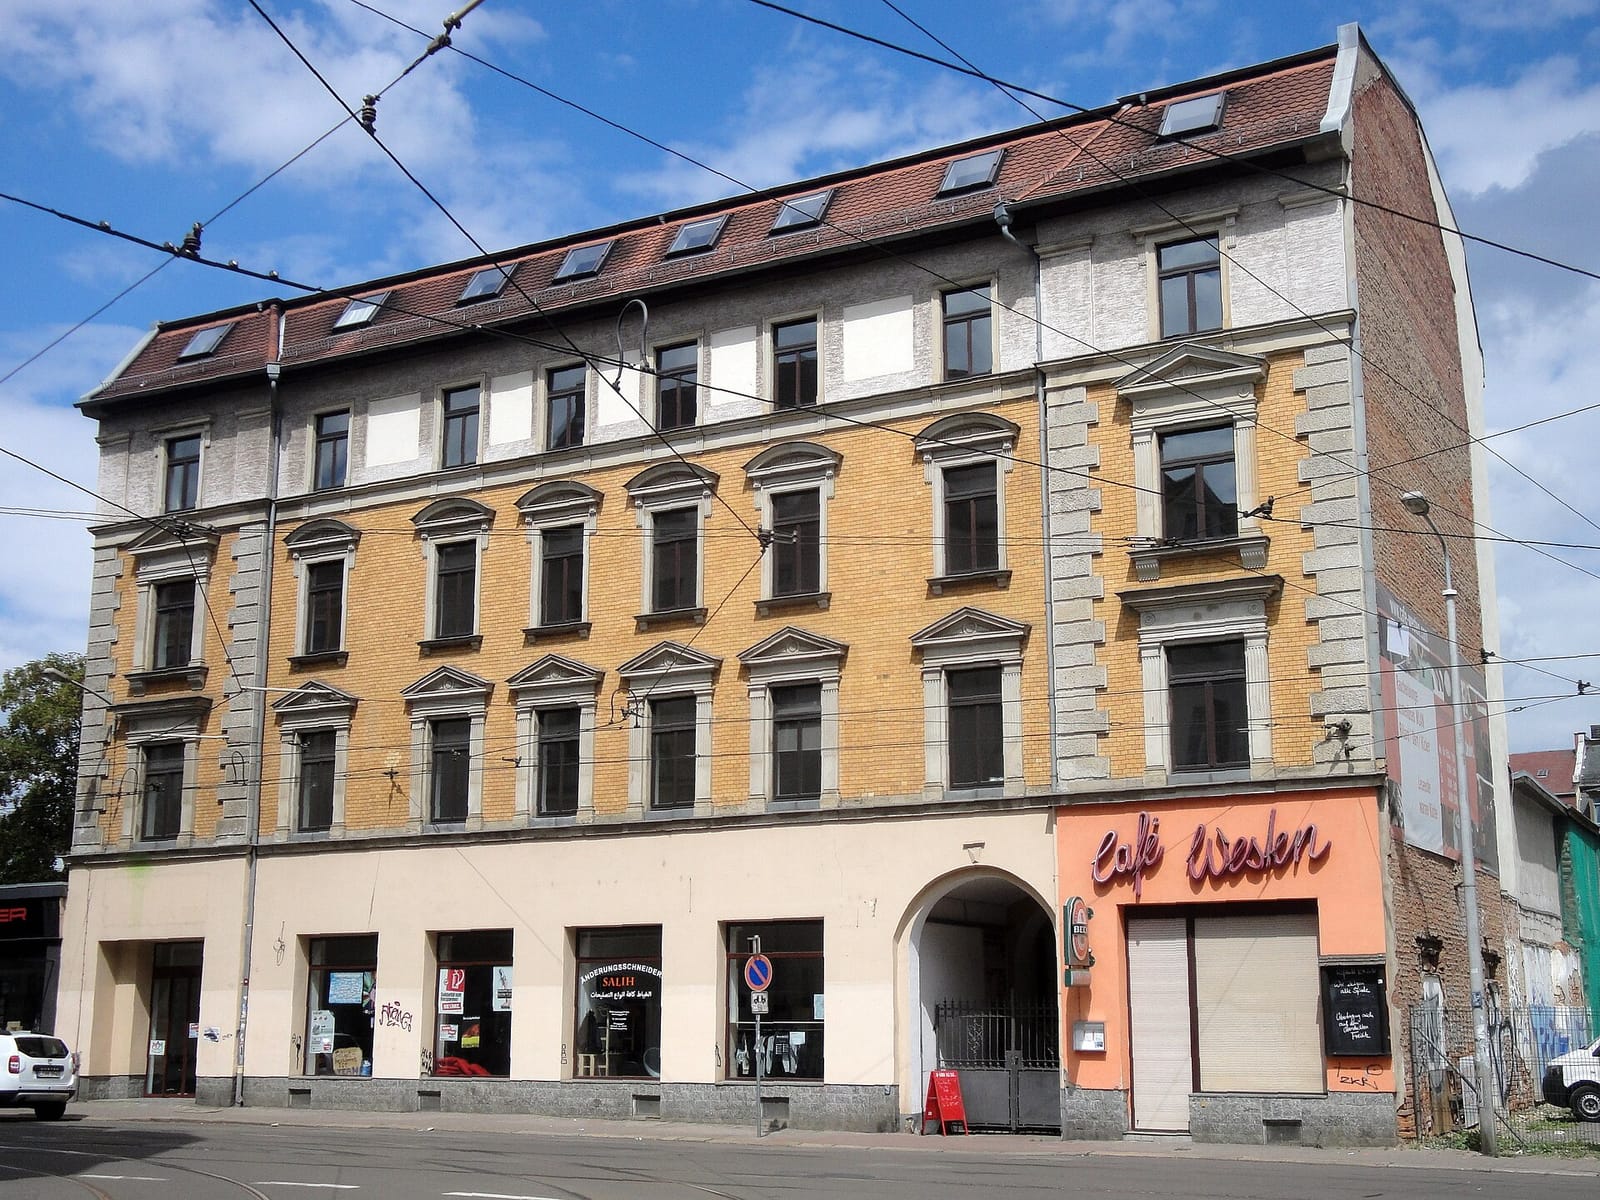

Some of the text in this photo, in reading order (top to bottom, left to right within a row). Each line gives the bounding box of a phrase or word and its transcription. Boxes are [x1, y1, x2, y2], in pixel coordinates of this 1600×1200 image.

[1092, 808, 1332, 897] Café Westen
[602, 976, 635, 987] SALIH
